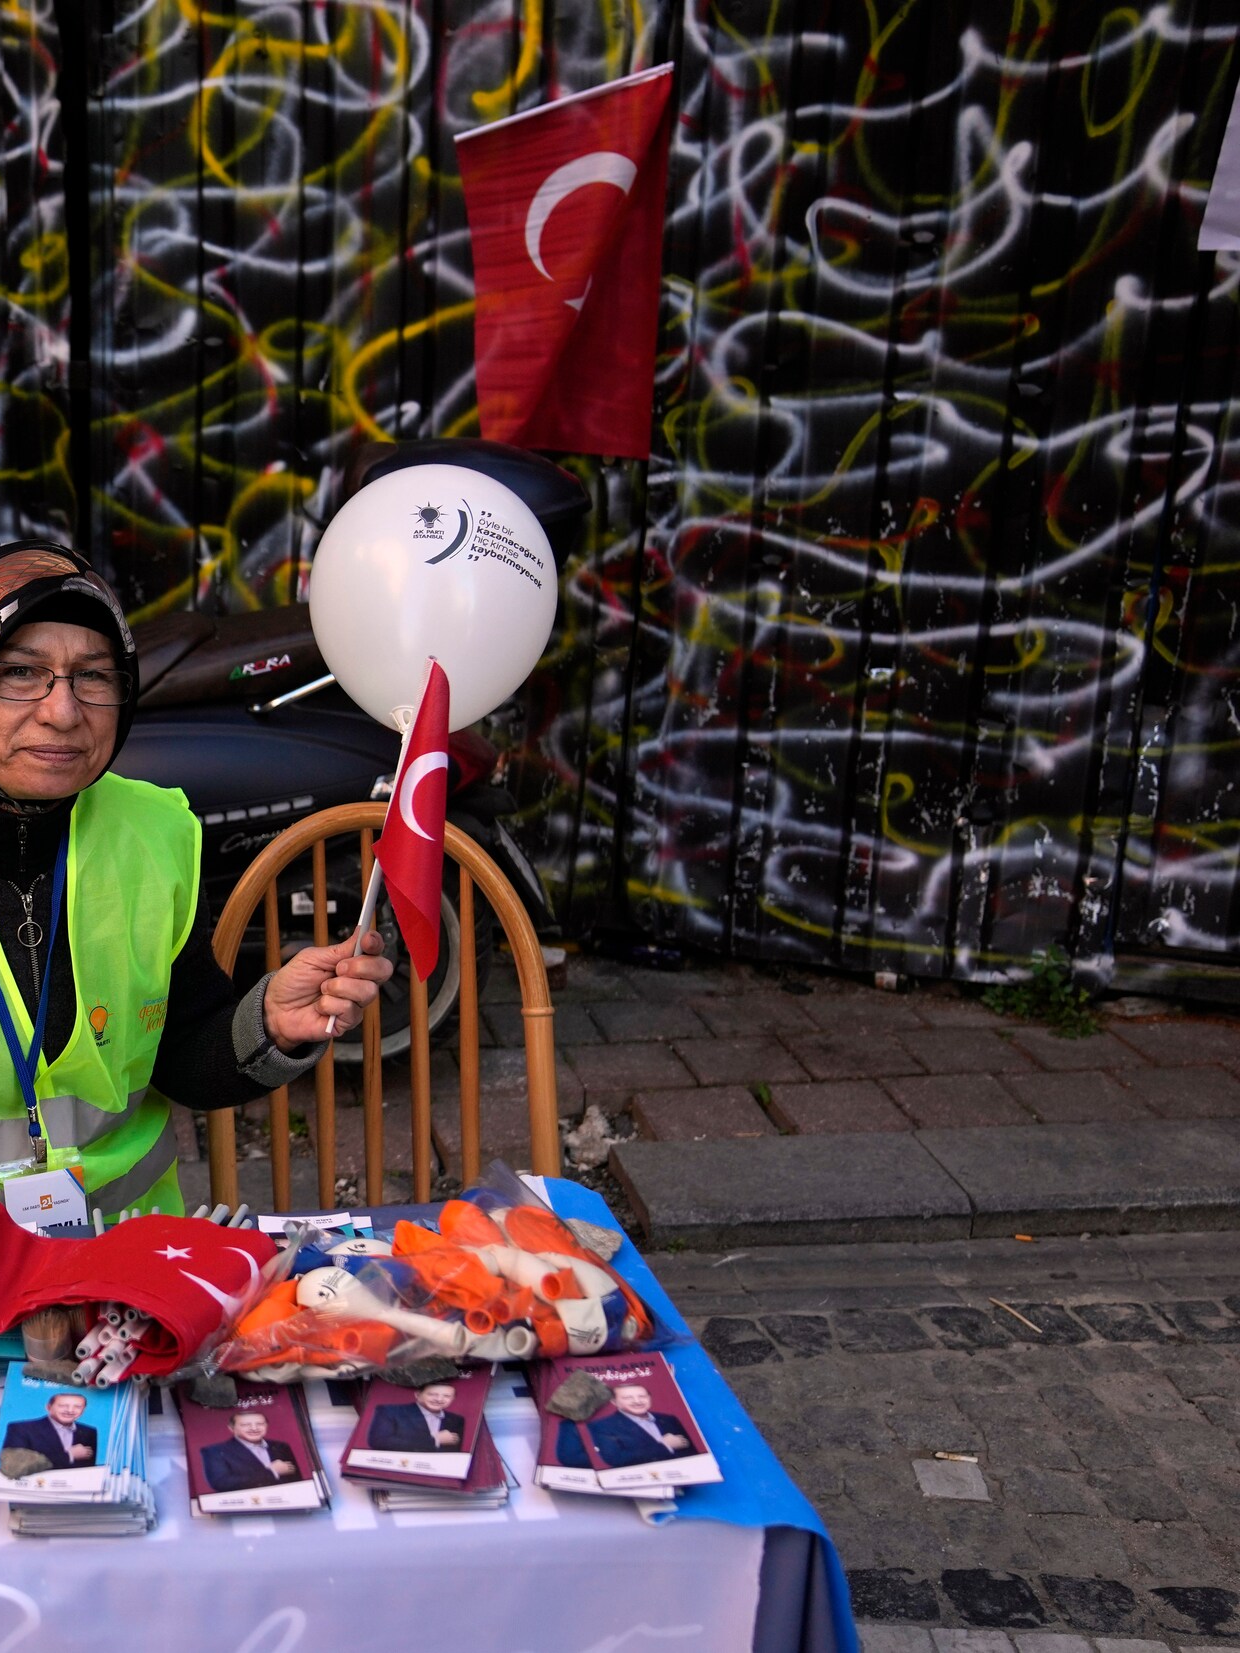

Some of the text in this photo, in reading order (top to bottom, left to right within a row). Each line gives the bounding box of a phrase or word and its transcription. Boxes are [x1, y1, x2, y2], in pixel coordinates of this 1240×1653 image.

[478, 517, 515, 537] öyle bir
[473, 535, 520, 559] hiç kimse
[476, 525, 544, 569] kazanacağız ki
[470, 543, 543, 590] kaybetmeyecek
[563, 1360, 656, 1373] KDINLARIN
